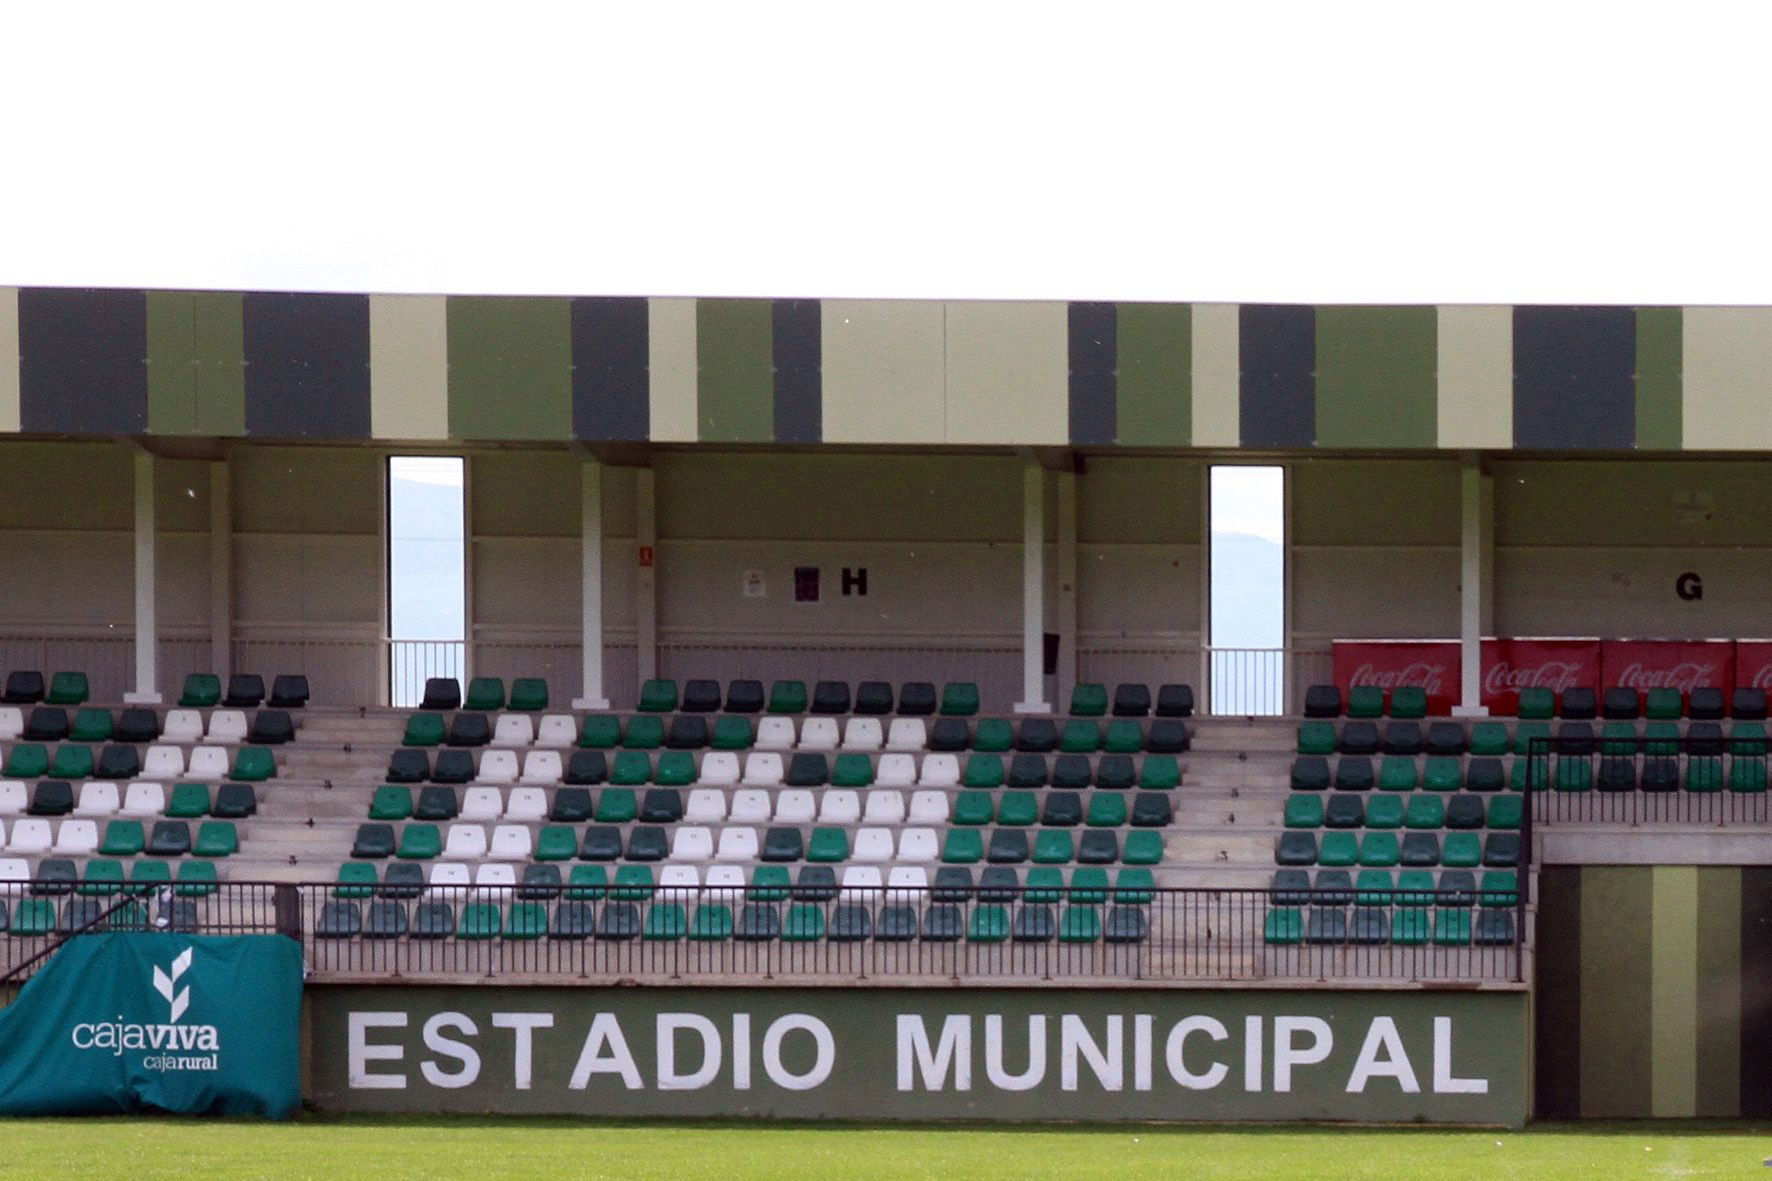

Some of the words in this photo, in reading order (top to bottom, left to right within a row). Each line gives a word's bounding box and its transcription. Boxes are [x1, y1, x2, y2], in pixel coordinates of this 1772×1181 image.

[841, 567, 868, 596] H
[1675, 571, 1703, 601] G
[349, 1012, 835, 1091] ESTADIO
[897, 1014, 1488, 1094] MUNICIPAL
